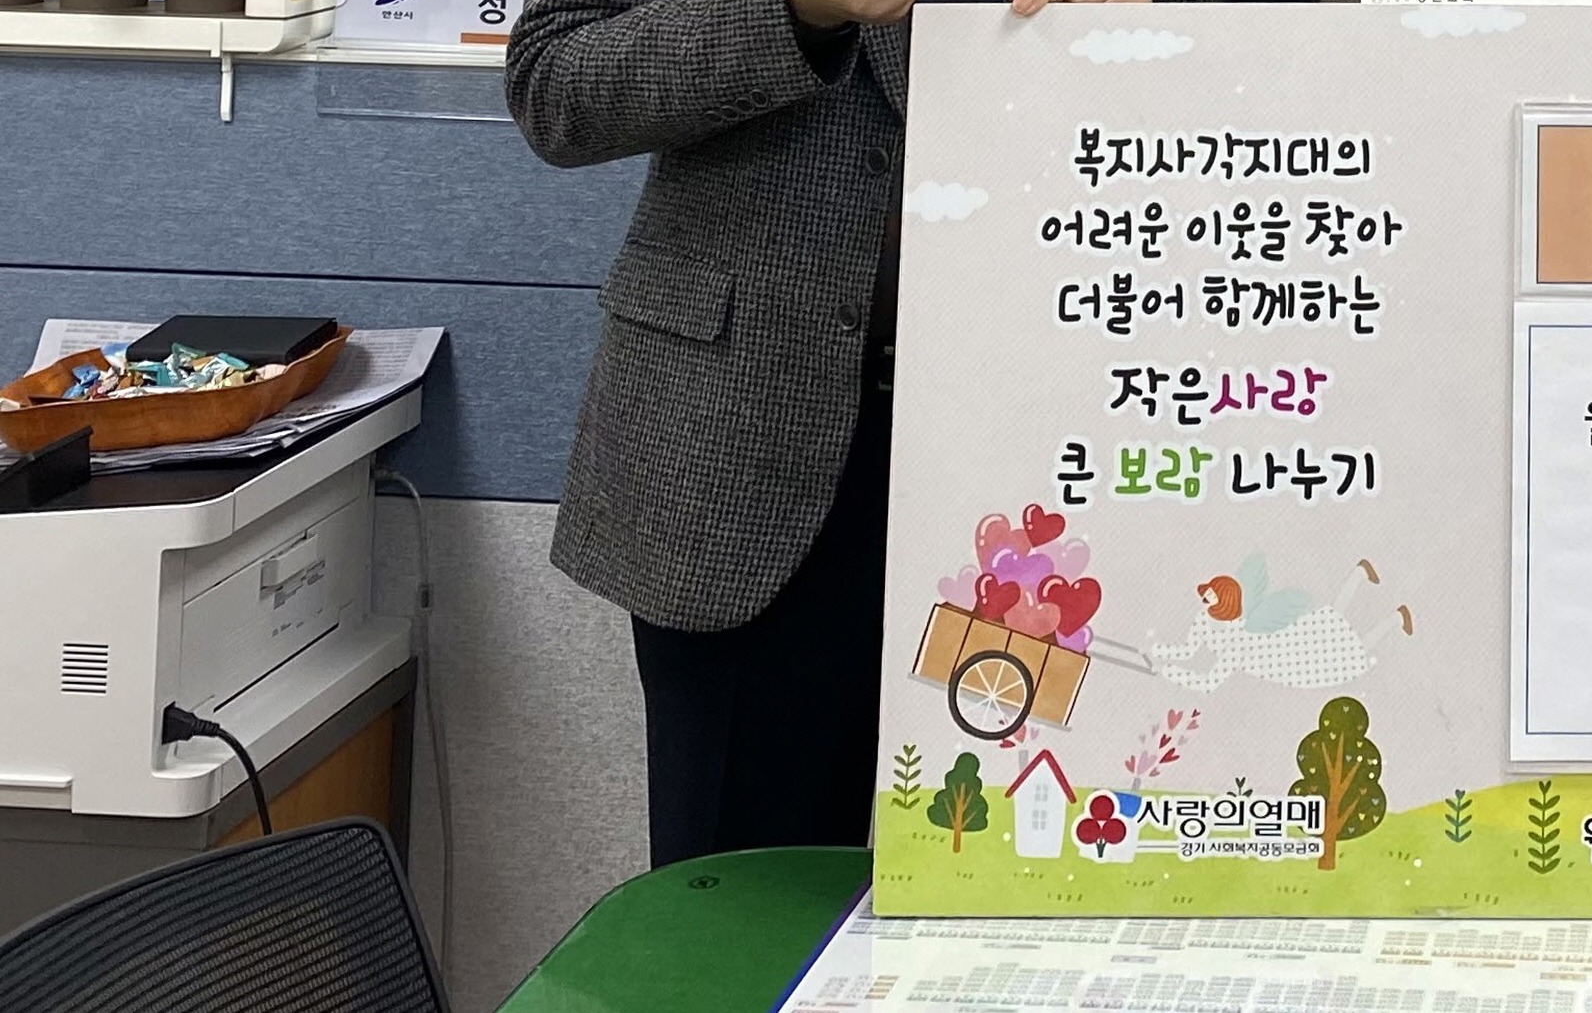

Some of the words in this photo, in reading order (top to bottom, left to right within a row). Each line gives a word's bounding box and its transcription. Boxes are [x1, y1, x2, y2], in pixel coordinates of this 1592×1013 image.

[381, 10, 414, 20] 안산시
[1074, 127, 1370, 187] 복지사각지대의
[1041, 201, 1169, 259] 어려운
[1186, 201, 1291, 261] 이웃을
[1305, 201, 1402, 257] 찾아
[1058, 273, 1184, 334] 더불어
[1202, 274, 1380, 334] 함께하는
[1057, 442, 1095, 505] 큰
[1115, 446, 1213, 498] 보람
[1231, 448, 1374, 499] 나누기
[1137, 800, 1320, 837] 사랑의열매
[1181, 842, 1206, 857] 경기
[1210, 842, 1320, 856] 사회복지공동모금회
